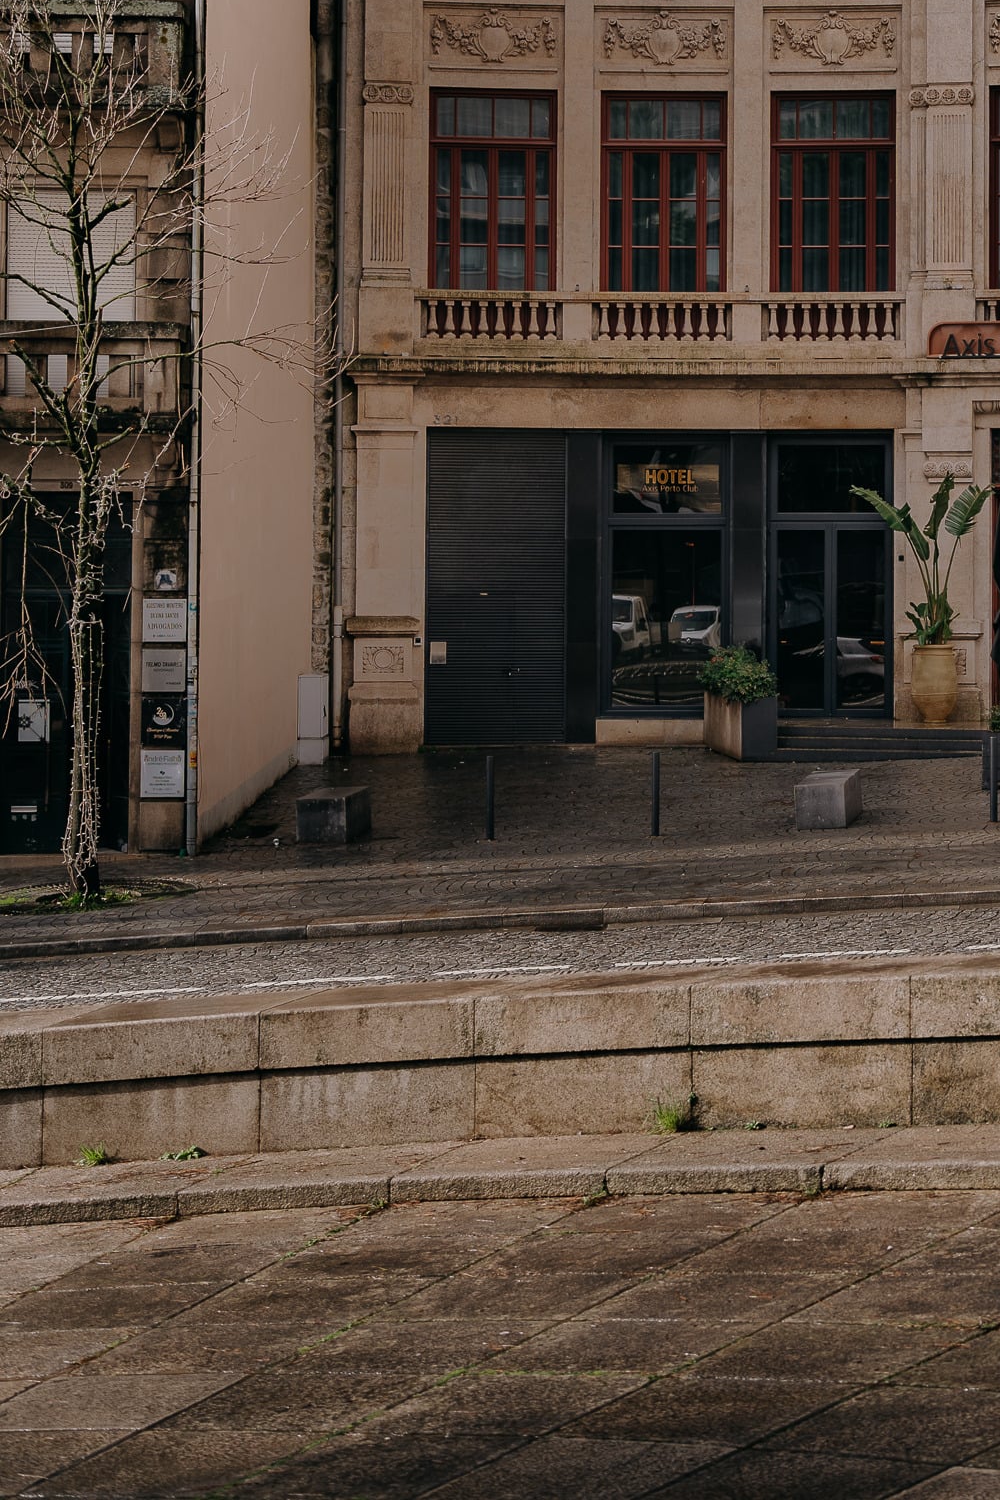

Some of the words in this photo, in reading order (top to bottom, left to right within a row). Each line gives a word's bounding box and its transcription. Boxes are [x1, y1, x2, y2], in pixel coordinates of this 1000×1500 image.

[943, 333, 995, 357] Axis
[433, 414, 458, 425] 321
[645, 469, 696, 485] HOTEL
[642, 485, 658, 493] Axis
[660, 485, 680, 493] Porto
[682, 485, 699, 493] Club
